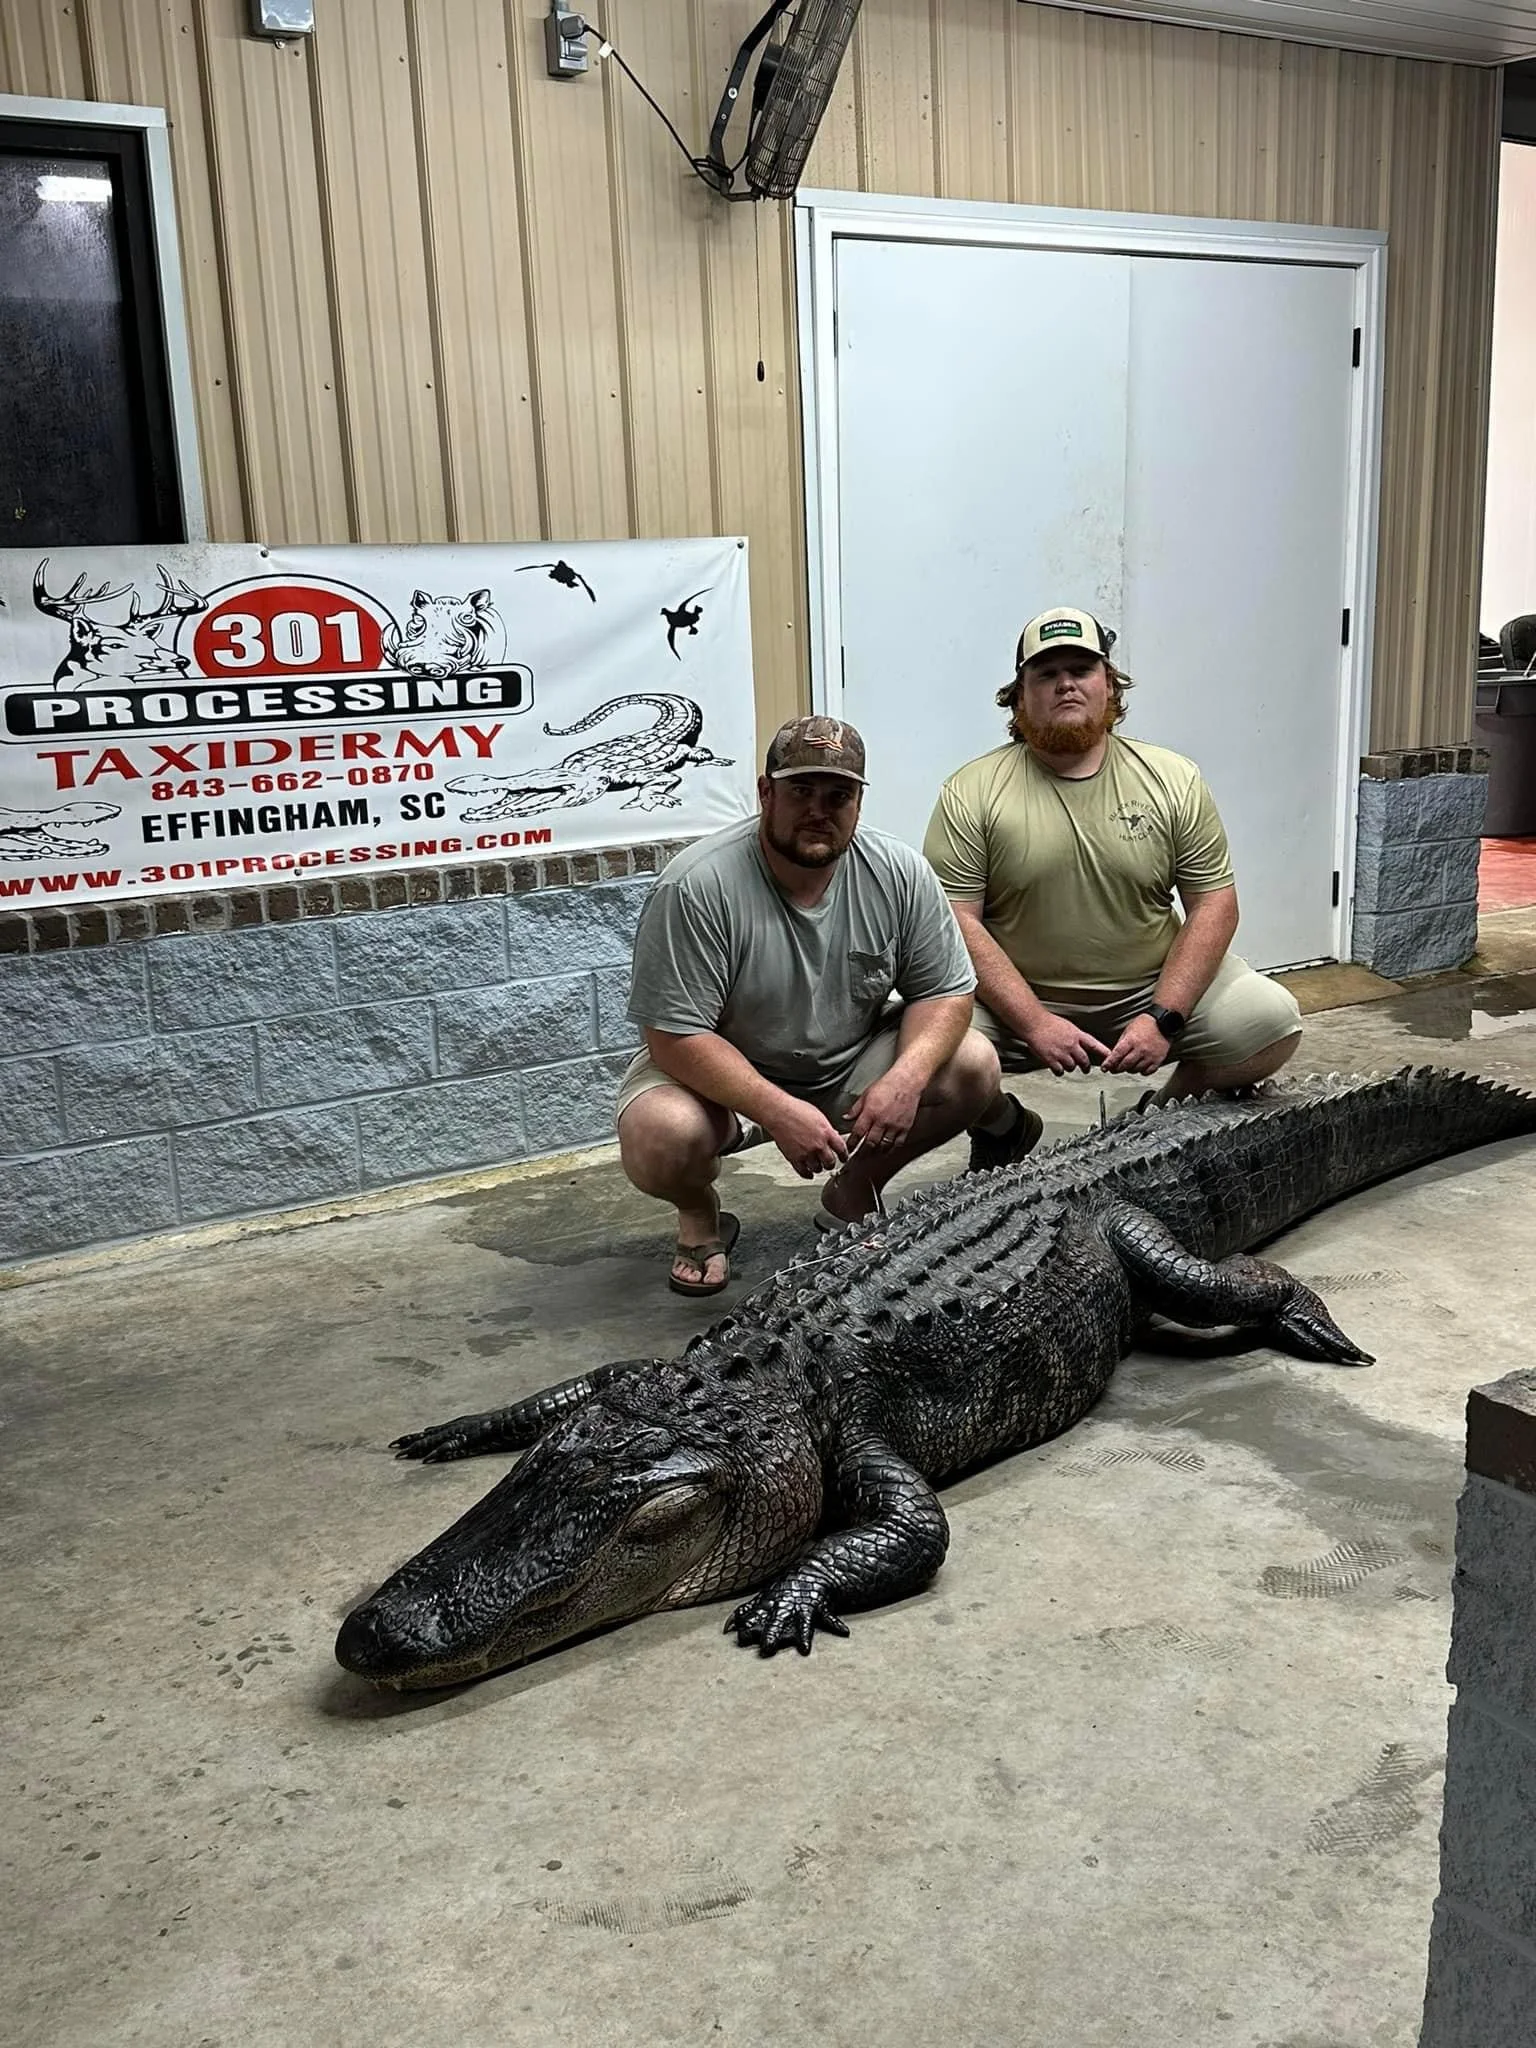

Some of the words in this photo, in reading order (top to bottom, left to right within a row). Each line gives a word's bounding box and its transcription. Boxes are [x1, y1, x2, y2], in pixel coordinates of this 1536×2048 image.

[211, 611, 363, 668] 301
[33, 677, 502, 728] PROCESSING
[37, 724, 504, 790] TAXIDERMY
[152, 763, 434, 800] 843-662-0870
[142, 798, 381, 843] EFFINGHAM,
[400, 792, 445, 820] SC
[0, 828, 552, 897] WWW.301PROCESSING.COM
